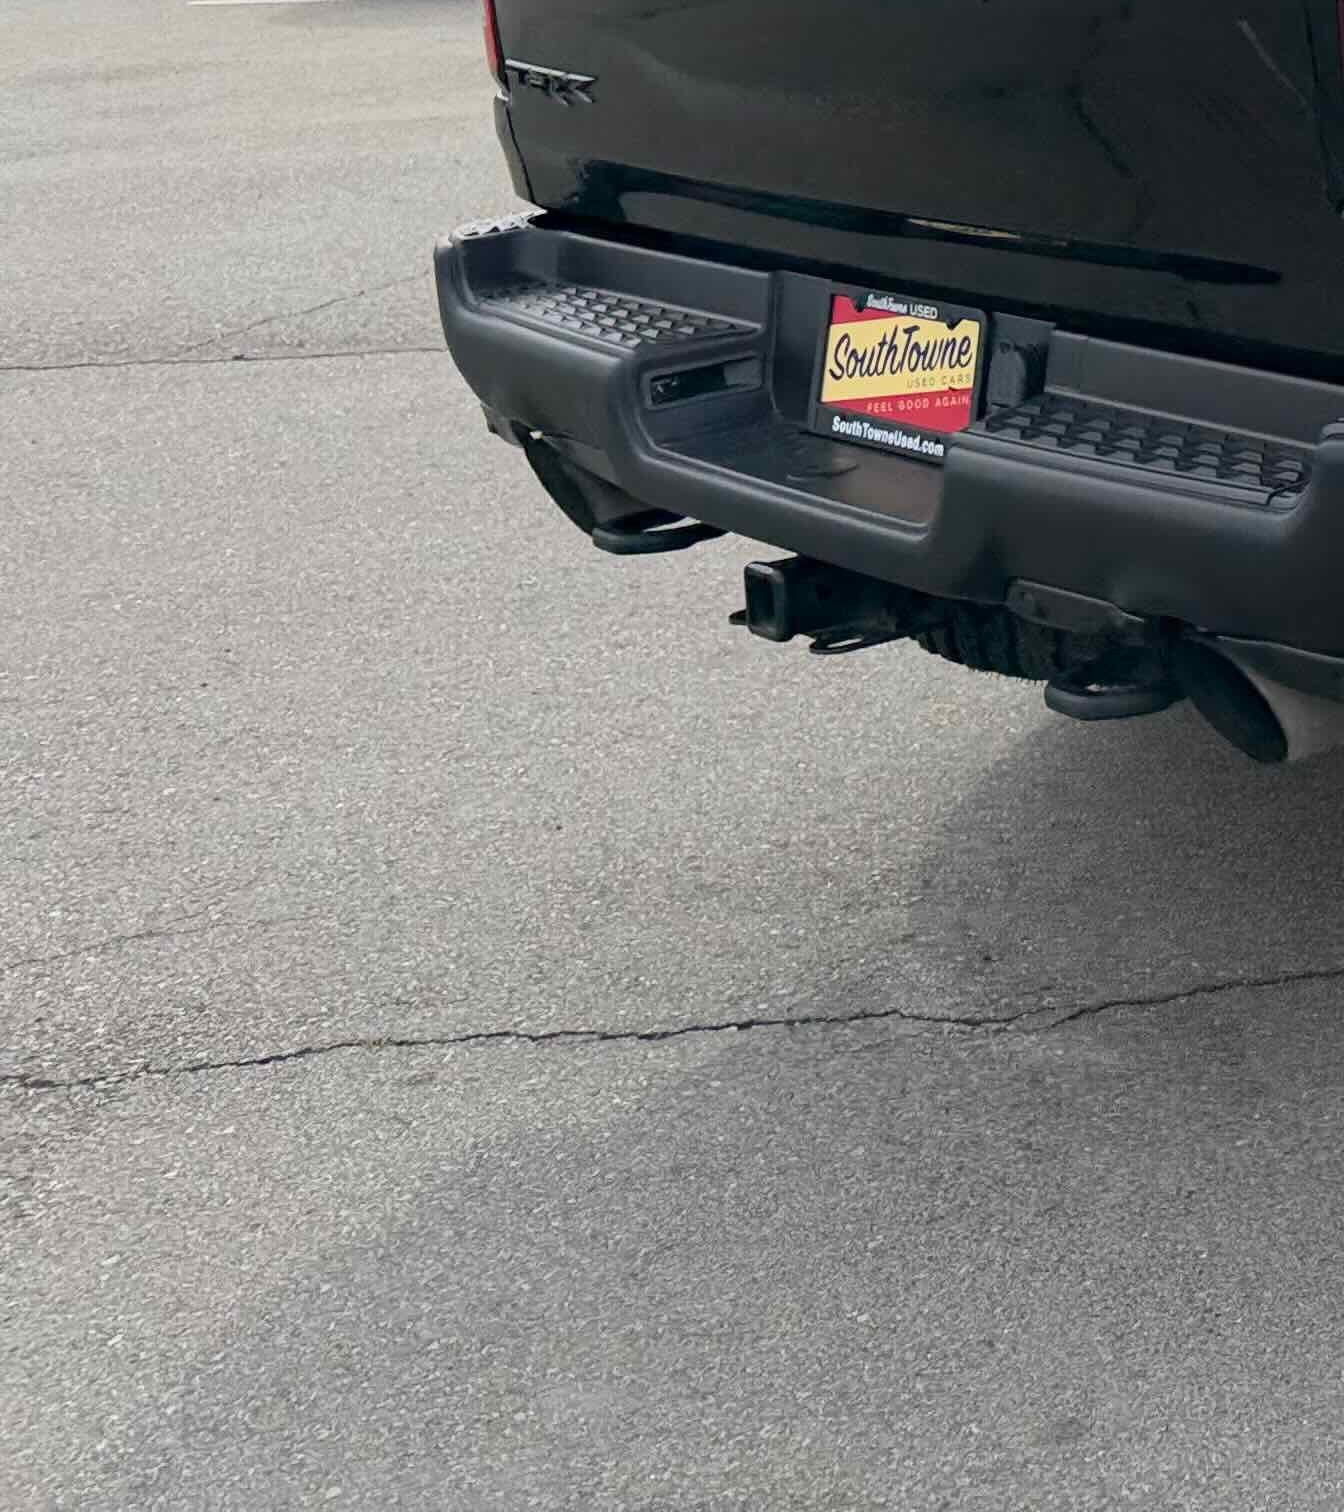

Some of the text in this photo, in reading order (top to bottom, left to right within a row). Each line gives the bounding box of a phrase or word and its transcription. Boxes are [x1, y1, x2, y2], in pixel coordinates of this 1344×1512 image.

[909, 304, 938, 319] USED
[829, 324, 973, 380] SouthTowne
[906, 374, 971, 388] USED CARS
[867, 395, 969, 413] FEEL GOOD AGAIN
[832, 416, 944, 456] SouthTowneUsed.com
